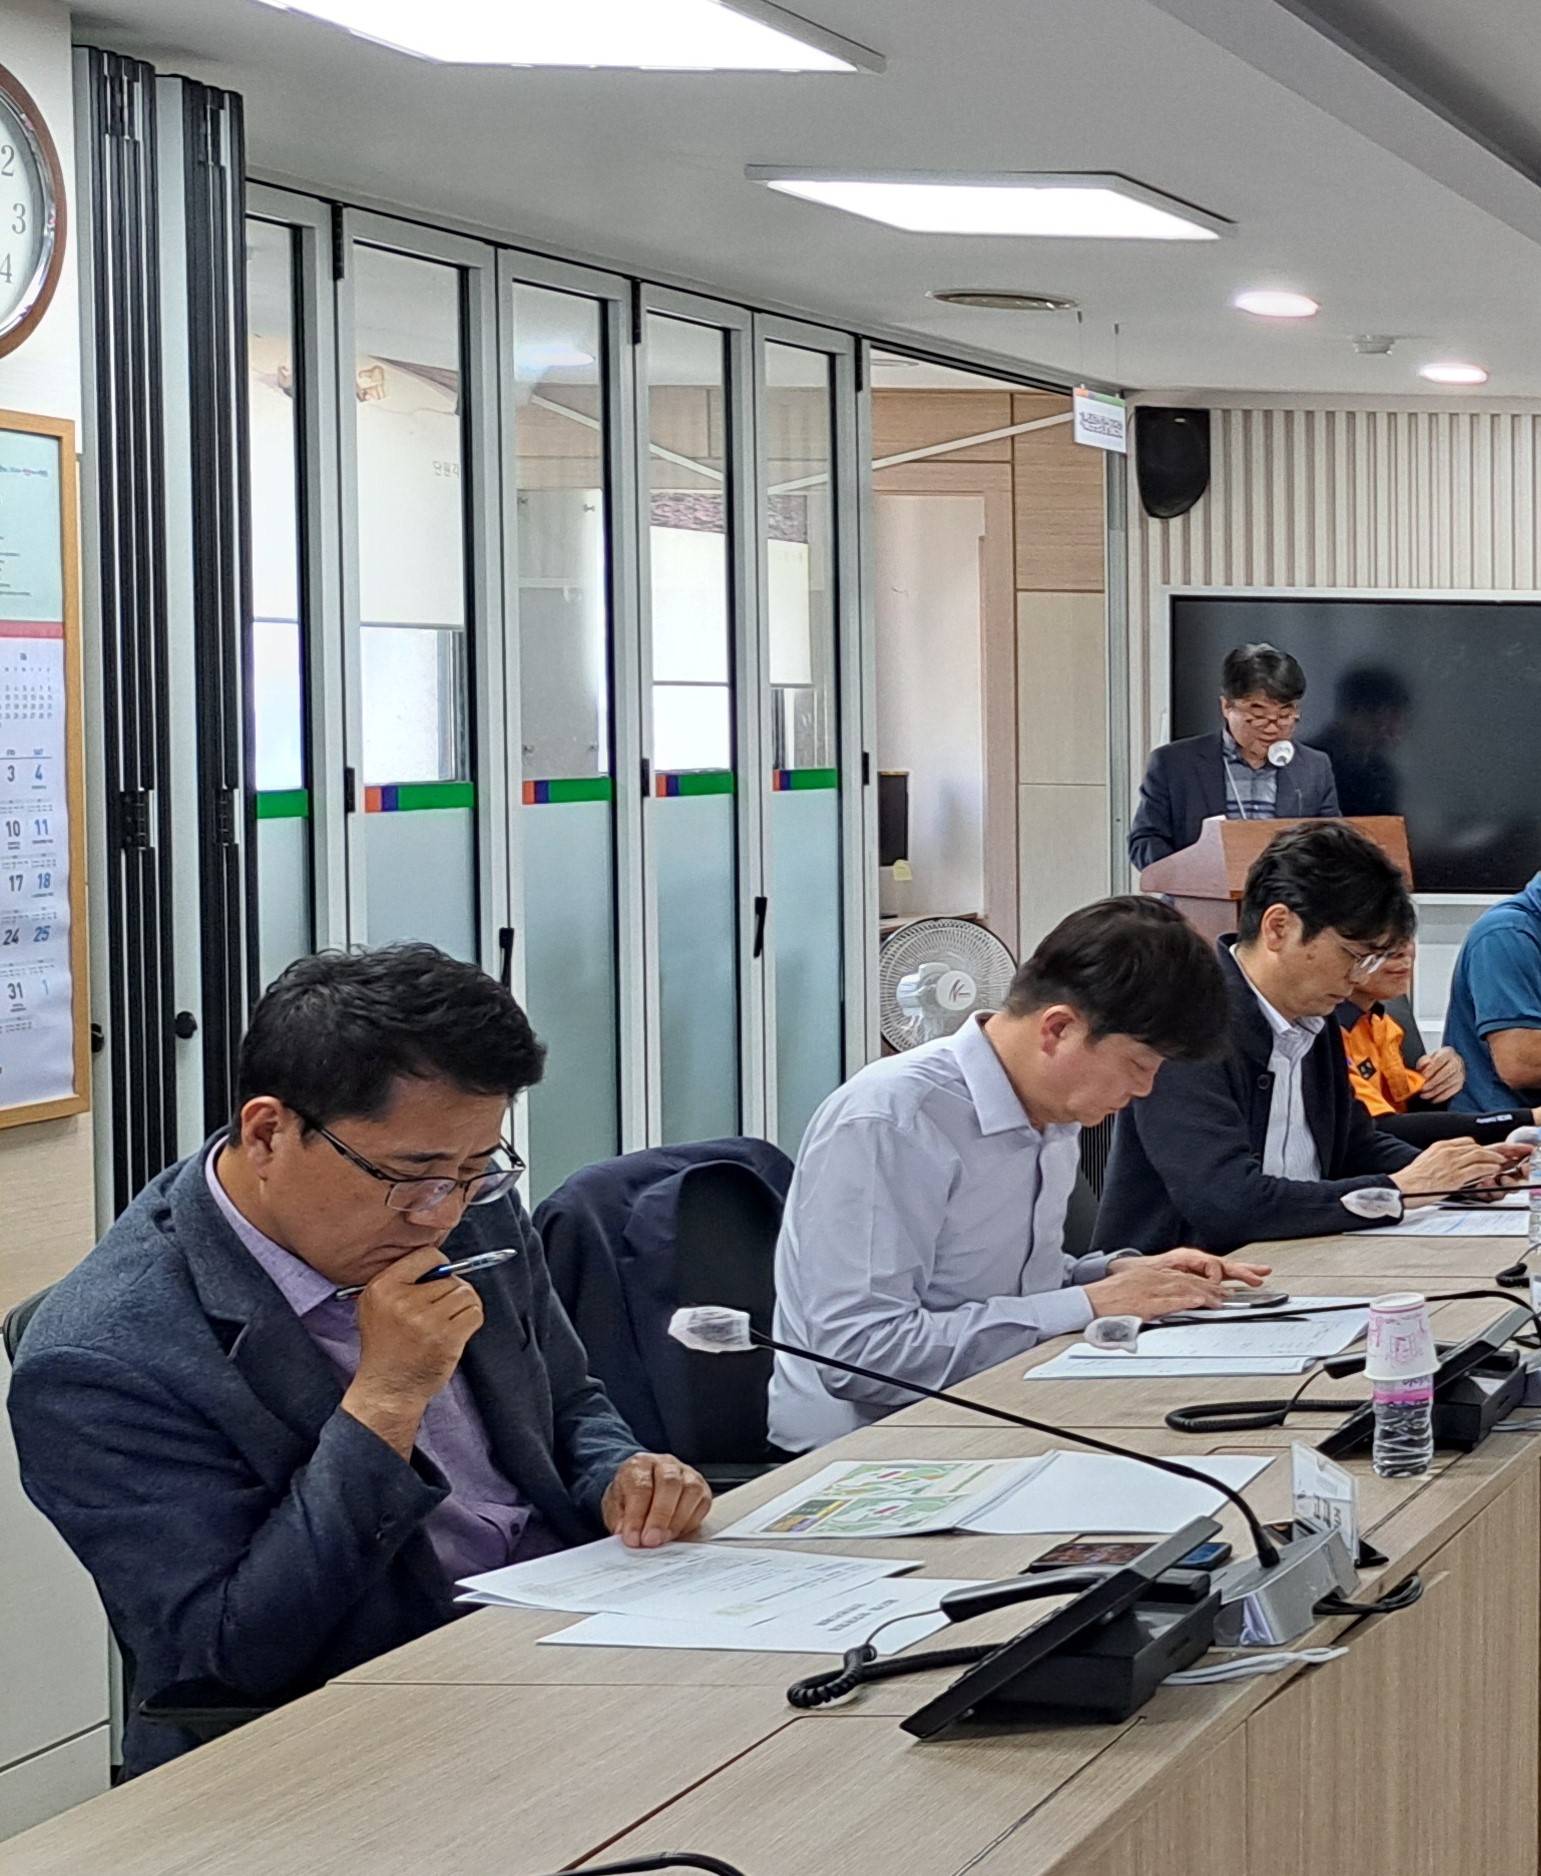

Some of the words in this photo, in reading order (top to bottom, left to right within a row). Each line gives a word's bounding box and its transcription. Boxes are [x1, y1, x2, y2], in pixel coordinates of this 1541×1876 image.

[1, 144, 15, 177] 2
[11, 202, 27, 235] 3
[0, 252, 13, 284] 4
[7, 765, 15, 782] 3
[35, 764, 43, 780] 4
[5, 820, 21, 838] 10
[34, 818, 49, 836] 11
[8, 874, 24, 892] 17
[37, 872, 52, 889] 18
[3, 928, 20, 946] 24
[33, 925, 51, 942] 25
[7, 982, 24, 1000] 31
